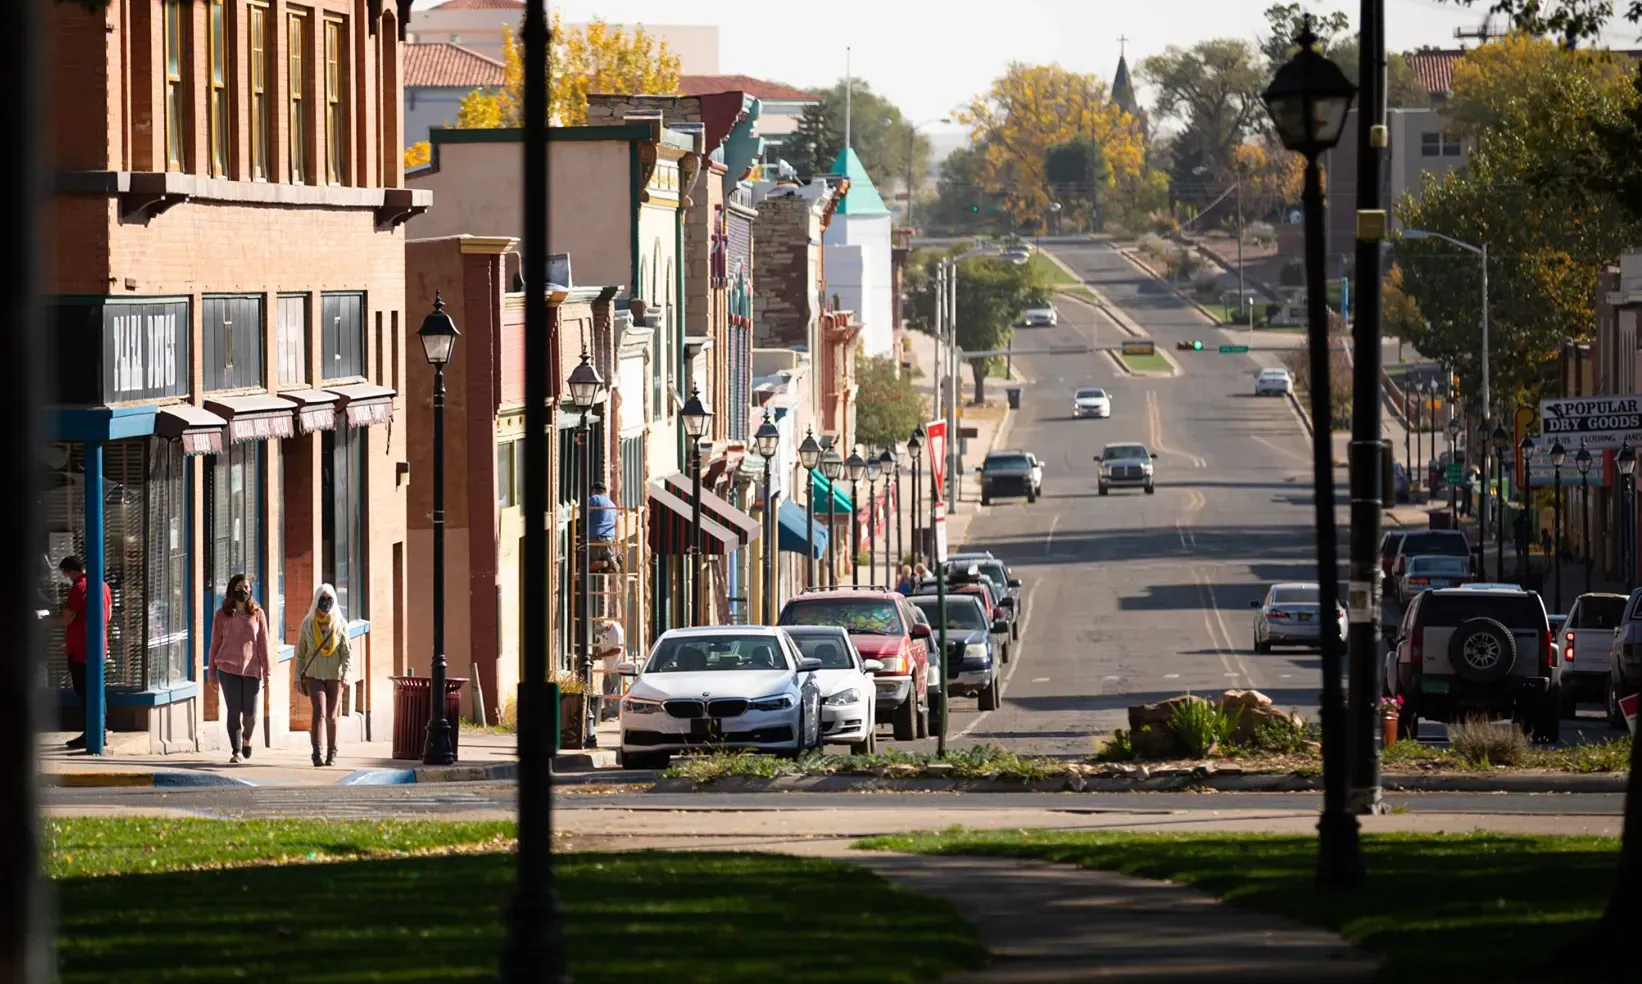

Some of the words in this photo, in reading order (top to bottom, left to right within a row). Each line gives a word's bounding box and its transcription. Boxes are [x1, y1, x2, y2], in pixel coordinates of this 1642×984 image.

[1564, 400, 1638, 415] POPULAR
[1549, 418, 1580, 431] DRY
[1588, 415, 1640, 429] GOODS
[1580, 434, 1616, 444] CLOTHING
